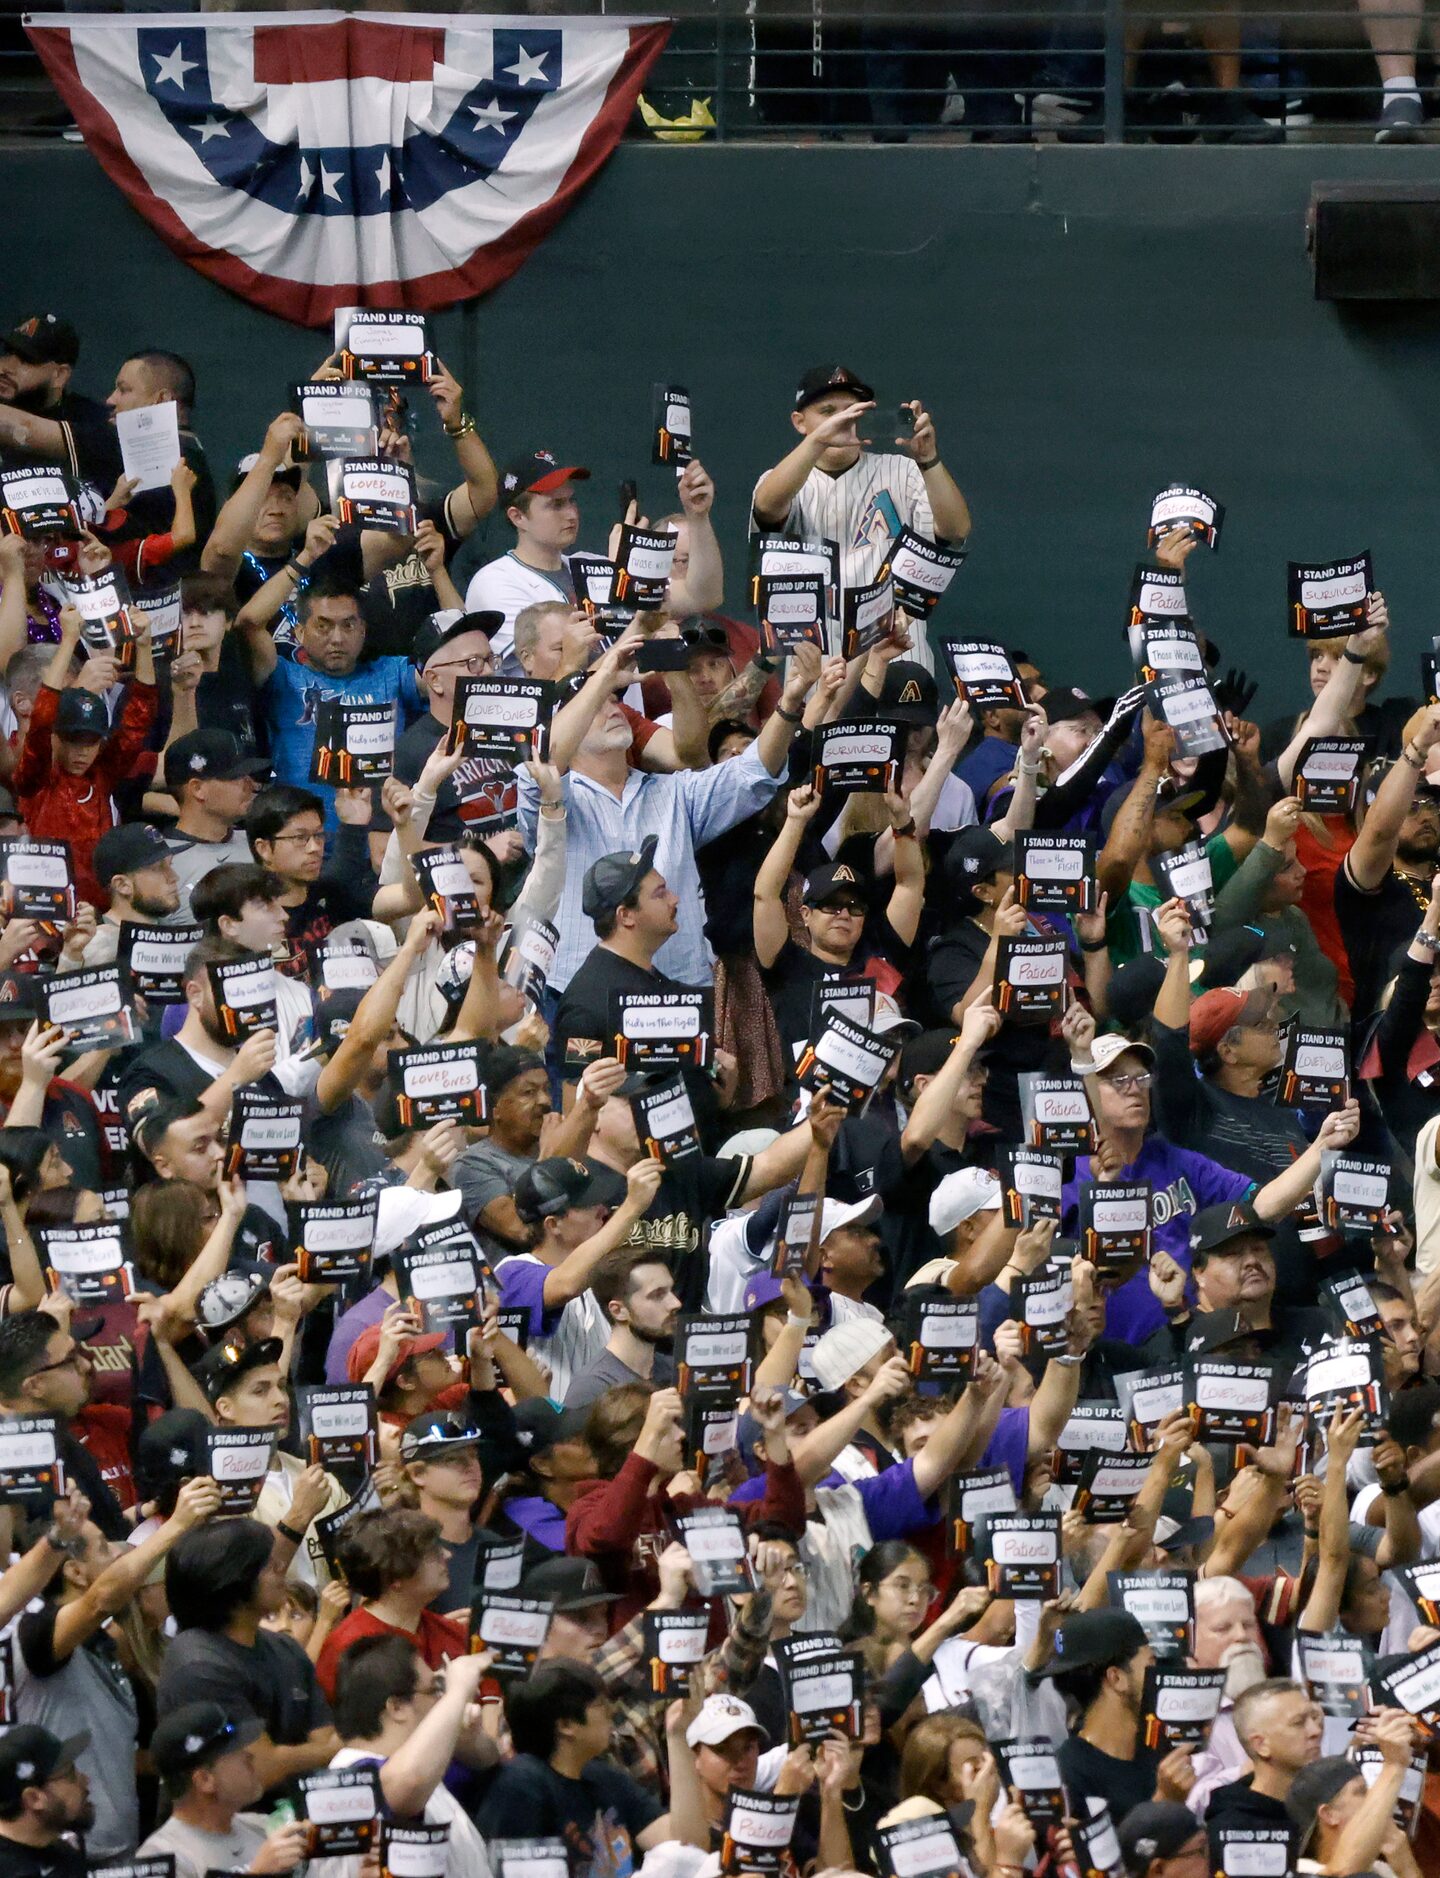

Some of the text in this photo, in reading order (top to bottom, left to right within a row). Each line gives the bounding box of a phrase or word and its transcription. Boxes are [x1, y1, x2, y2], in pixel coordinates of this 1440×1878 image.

[352, 314, 425, 324] STAND UP FOR
[345, 463, 378, 472] STAND
[396, 467, 409, 478] FOR
[351, 480, 386, 489] LOVED
[381, 489, 405, 499] ONES
[1156, 489, 1182, 502] STAND
[1185, 488, 1199, 496] UP
[1202, 494, 1216, 511] FOR
[1298, 560, 1366, 579] I STAND UP FOR
[1304, 583, 1364, 600] SURVIVORS
[471, 684, 501, 693] STAND
[504, 685, 518, 694] UP
[521, 686, 542, 696] FOR
[467, 703, 535, 721] LOVED ONES
[822, 731, 825, 739] I
[828, 726, 856, 737] STAND
[876, 724, 897, 734] FOR
[825, 744, 888, 758] SURVIVORS
[1024, 838, 1086, 848] I STAND UP FOR
[1008, 944, 1012, 952] I
[1015, 944, 1043, 953] STAND
[1019, 963, 1056, 980] Patients
[619, 994, 702, 1006] I STAND UP FOR
[399, 1047, 477, 1066] I STAND UP FOR
[442, 1074, 471, 1088] ONES
[987, 1520, 992, 1530] I
[994, 1519, 1030, 1529] STAND
[1032, 1519, 1044, 1528] UP
